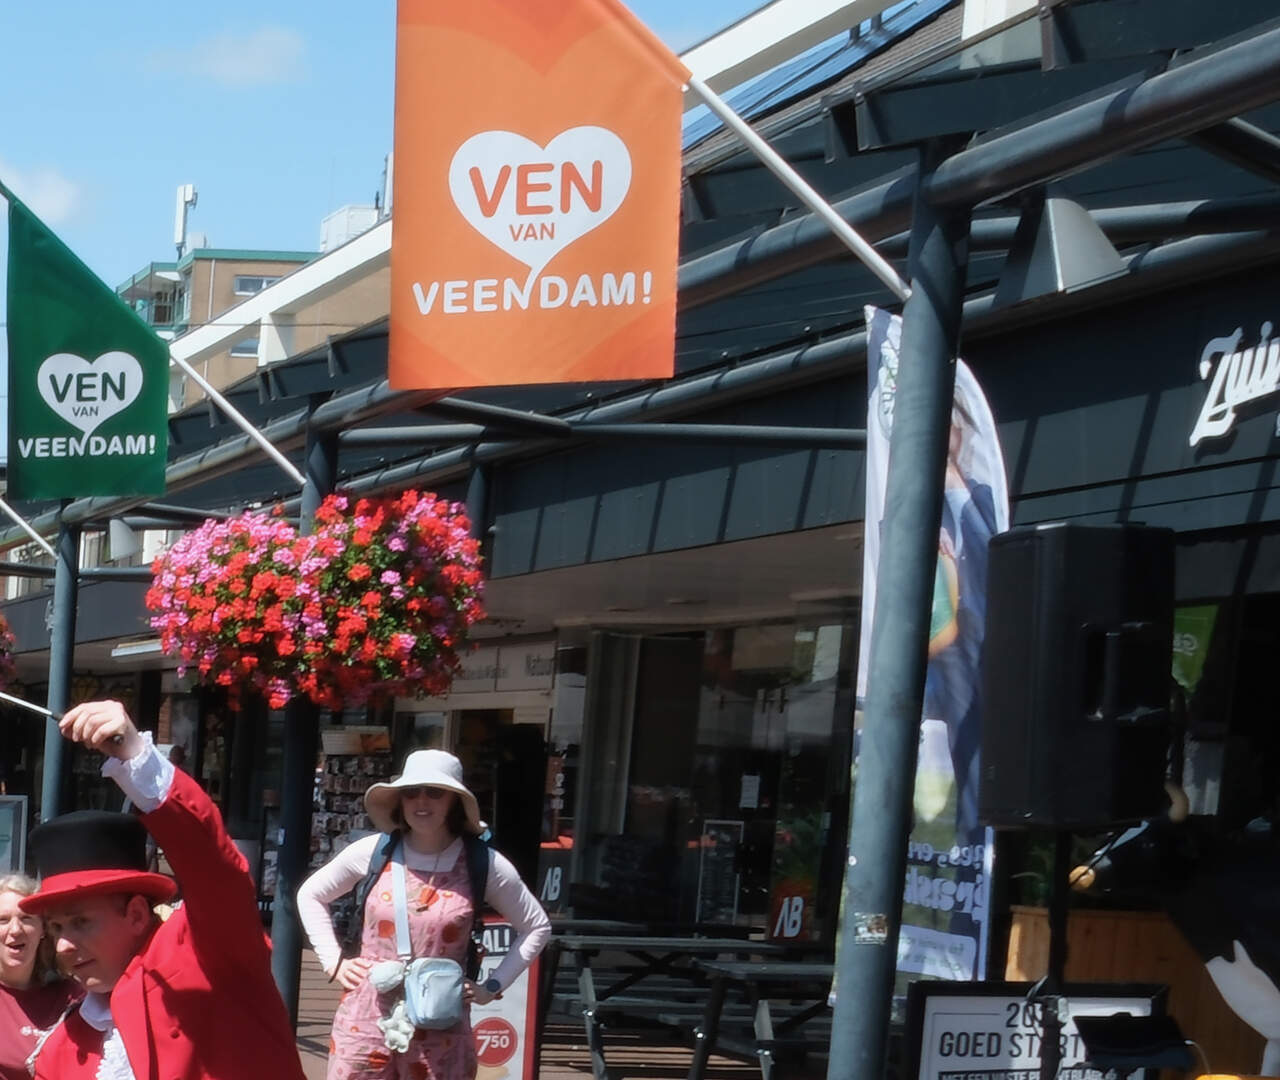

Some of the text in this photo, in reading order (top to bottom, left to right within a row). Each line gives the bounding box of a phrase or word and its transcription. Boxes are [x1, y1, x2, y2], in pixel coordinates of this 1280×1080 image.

[468, 159, 603, 218] VEN
[509, 222, 555, 242] VAN
[412, 271, 653, 315] VEENDAM!
[49, 371, 126, 403] VEN
[72, 406, 99, 417] VAN
[18, 434, 156, 458] VEENDAM!
[940, 1031, 1002, 1058] GOED
